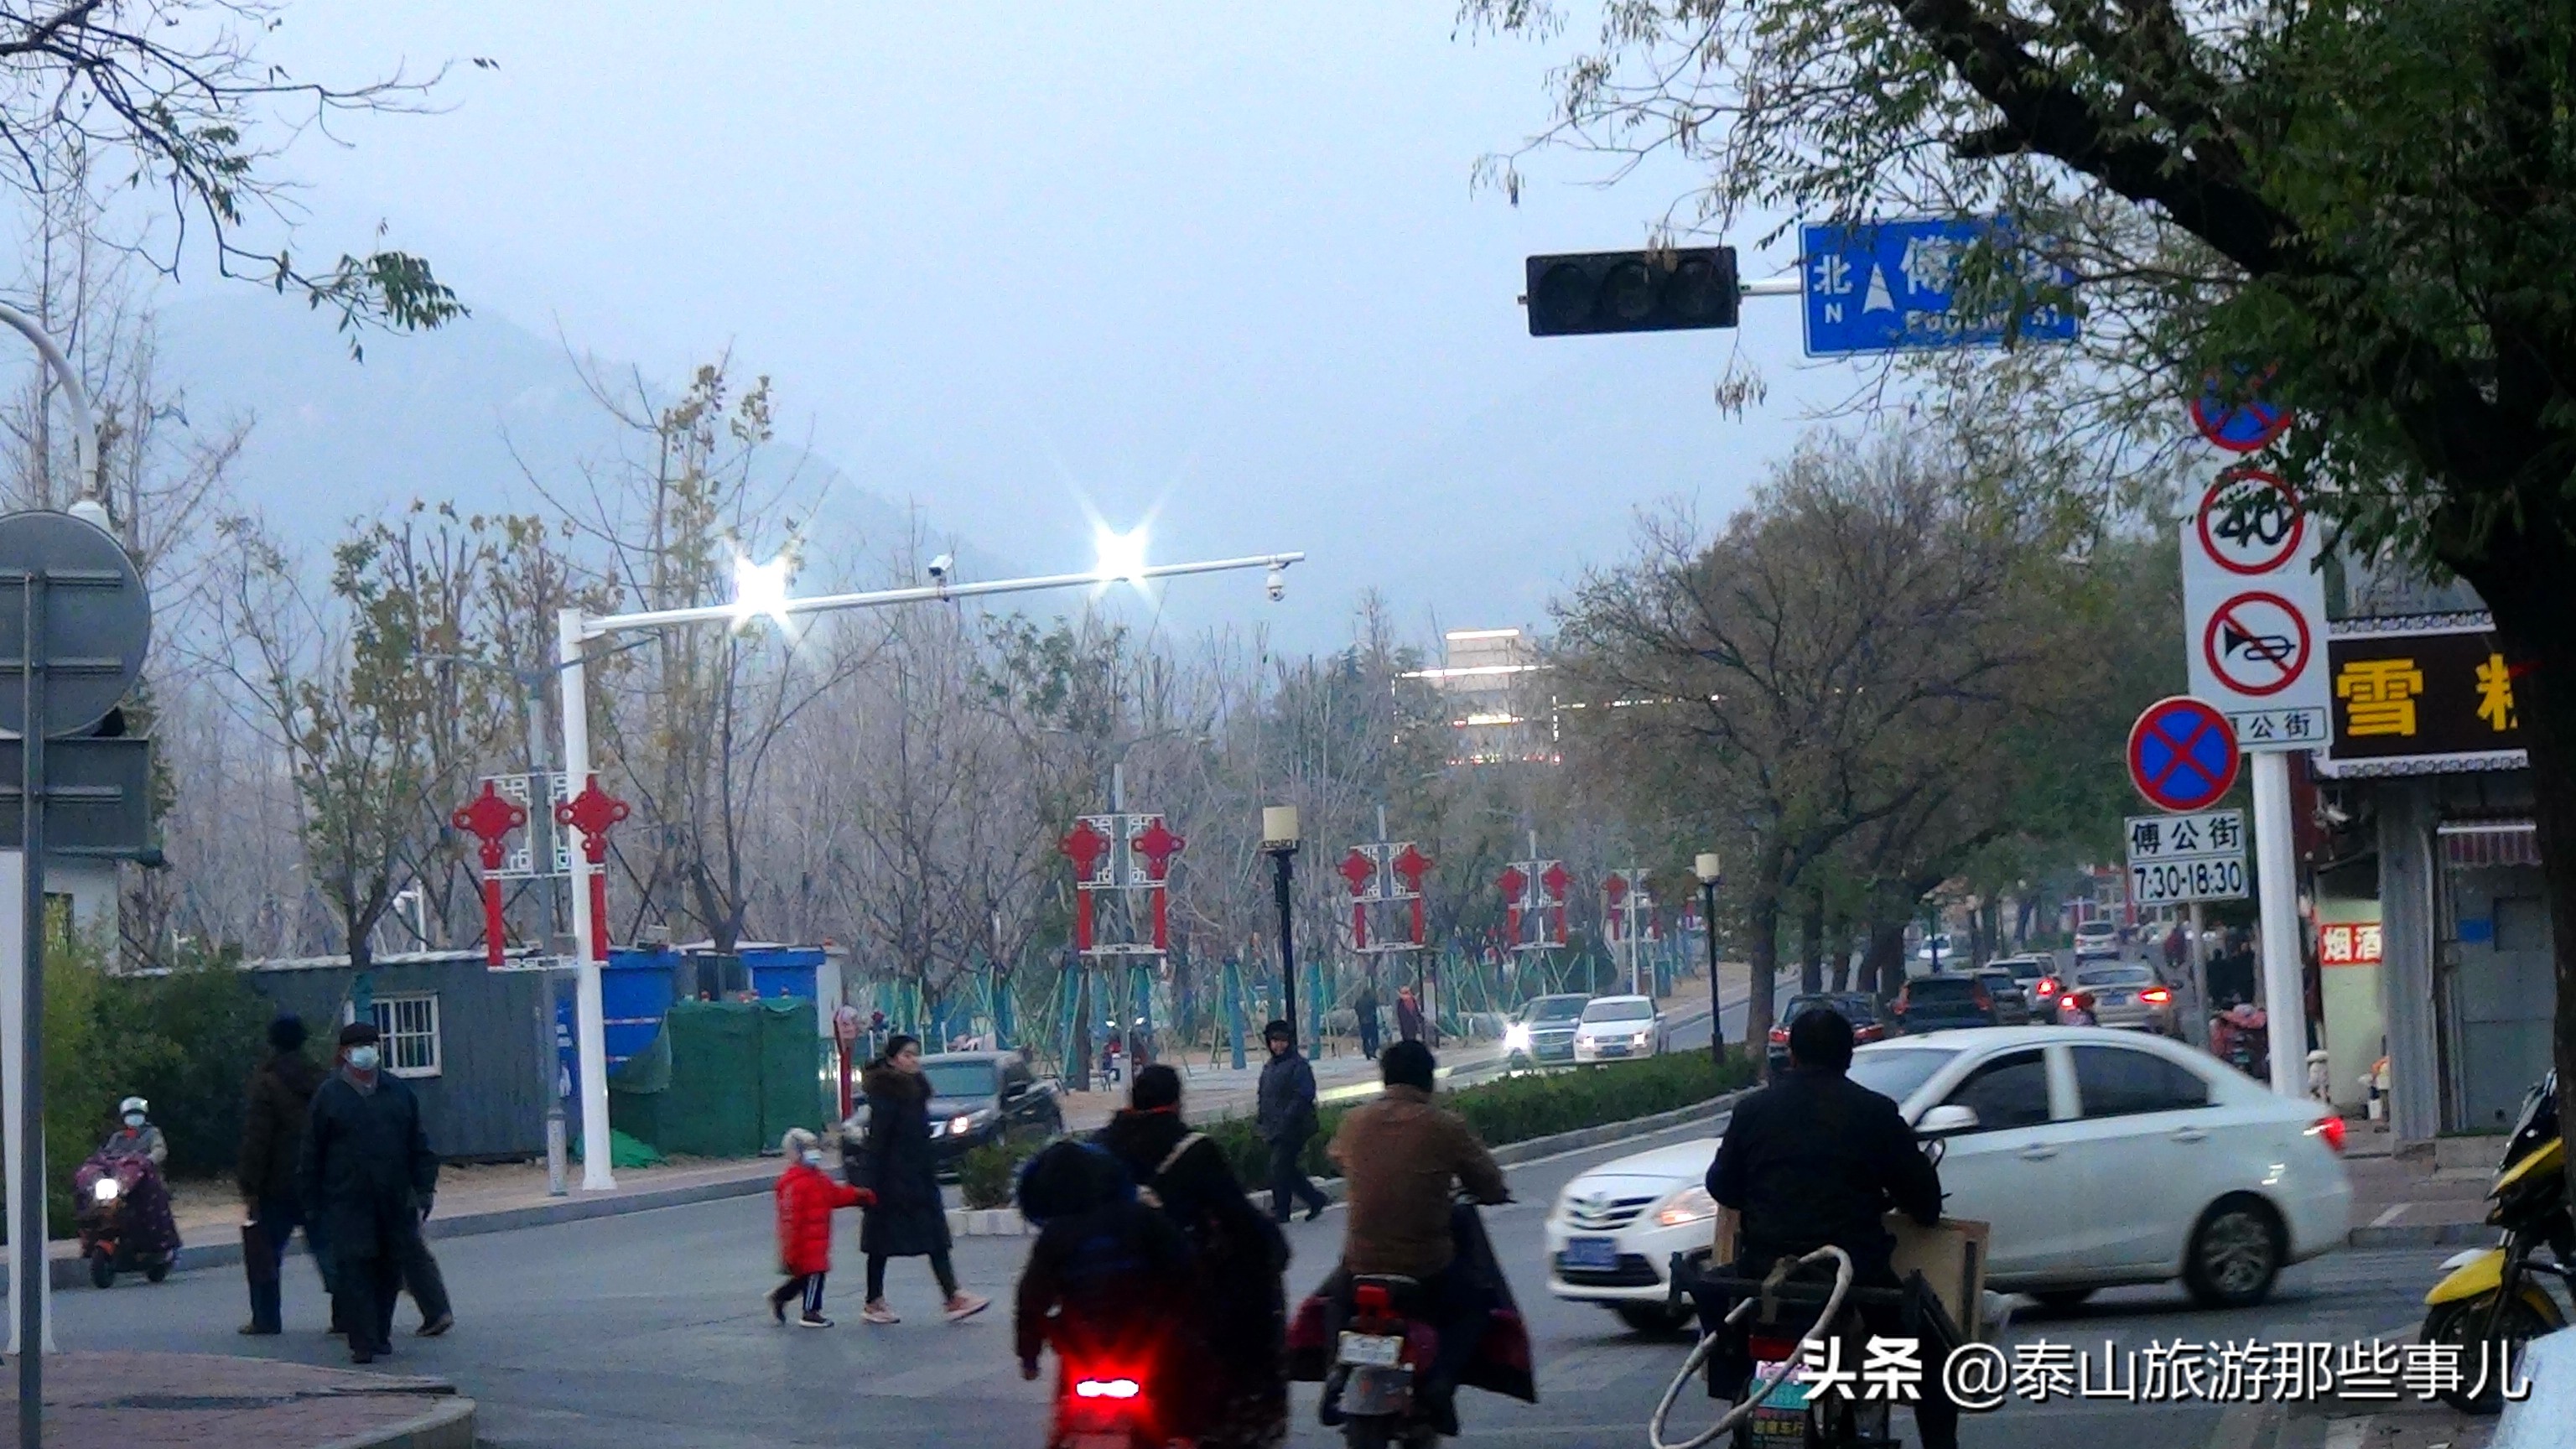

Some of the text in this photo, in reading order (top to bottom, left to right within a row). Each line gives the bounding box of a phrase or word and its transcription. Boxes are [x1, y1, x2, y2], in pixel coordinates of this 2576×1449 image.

[1813, 253, 1853, 295] 北
[1825, 302, 1843, 325] N
[2215, 496, 2283, 547] 40
[2231, 713, 2311, 738] 公街
[2134, 861, 2242, 899] 7:30-18:30
[2323, 926, 2381, 962] 烟酒
